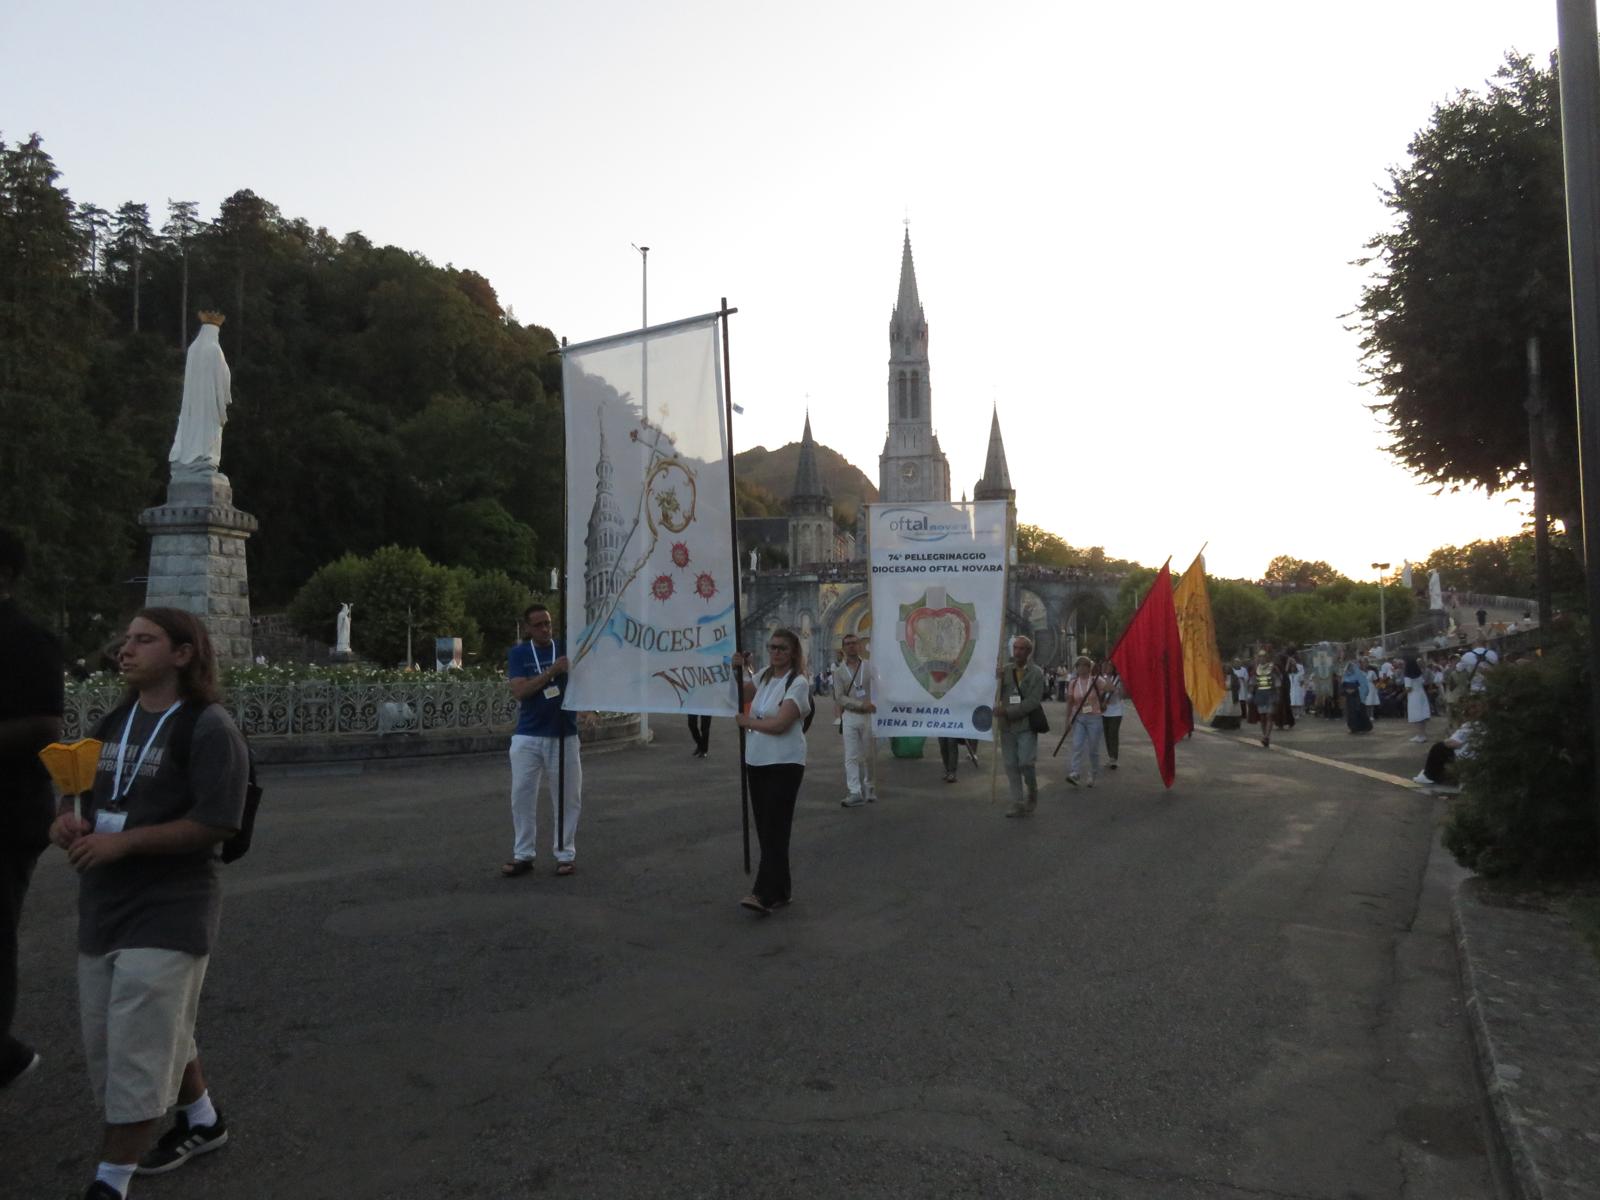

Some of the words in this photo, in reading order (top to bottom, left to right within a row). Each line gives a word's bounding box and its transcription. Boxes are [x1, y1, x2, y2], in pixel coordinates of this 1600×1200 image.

[889, 516, 928, 531] oftal
[904, 552, 987, 561] PELLEGRINAGGIO
[872, 565, 927, 574] DIOCESANO
[929, 565, 959, 573] OFTAL
[962, 564, 1004, 573] NOVARA
[623, 617, 703, 653] DIOCESI
[713, 625, 728, 642] DI
[891, 706, 913, 714] AVE
[915, 707, 951, 716] MARIA
[877, 718, 908, 727] PIENA
[911, 720, 923, 728] DI
[926, 721, 964, 729] GRAZIA
